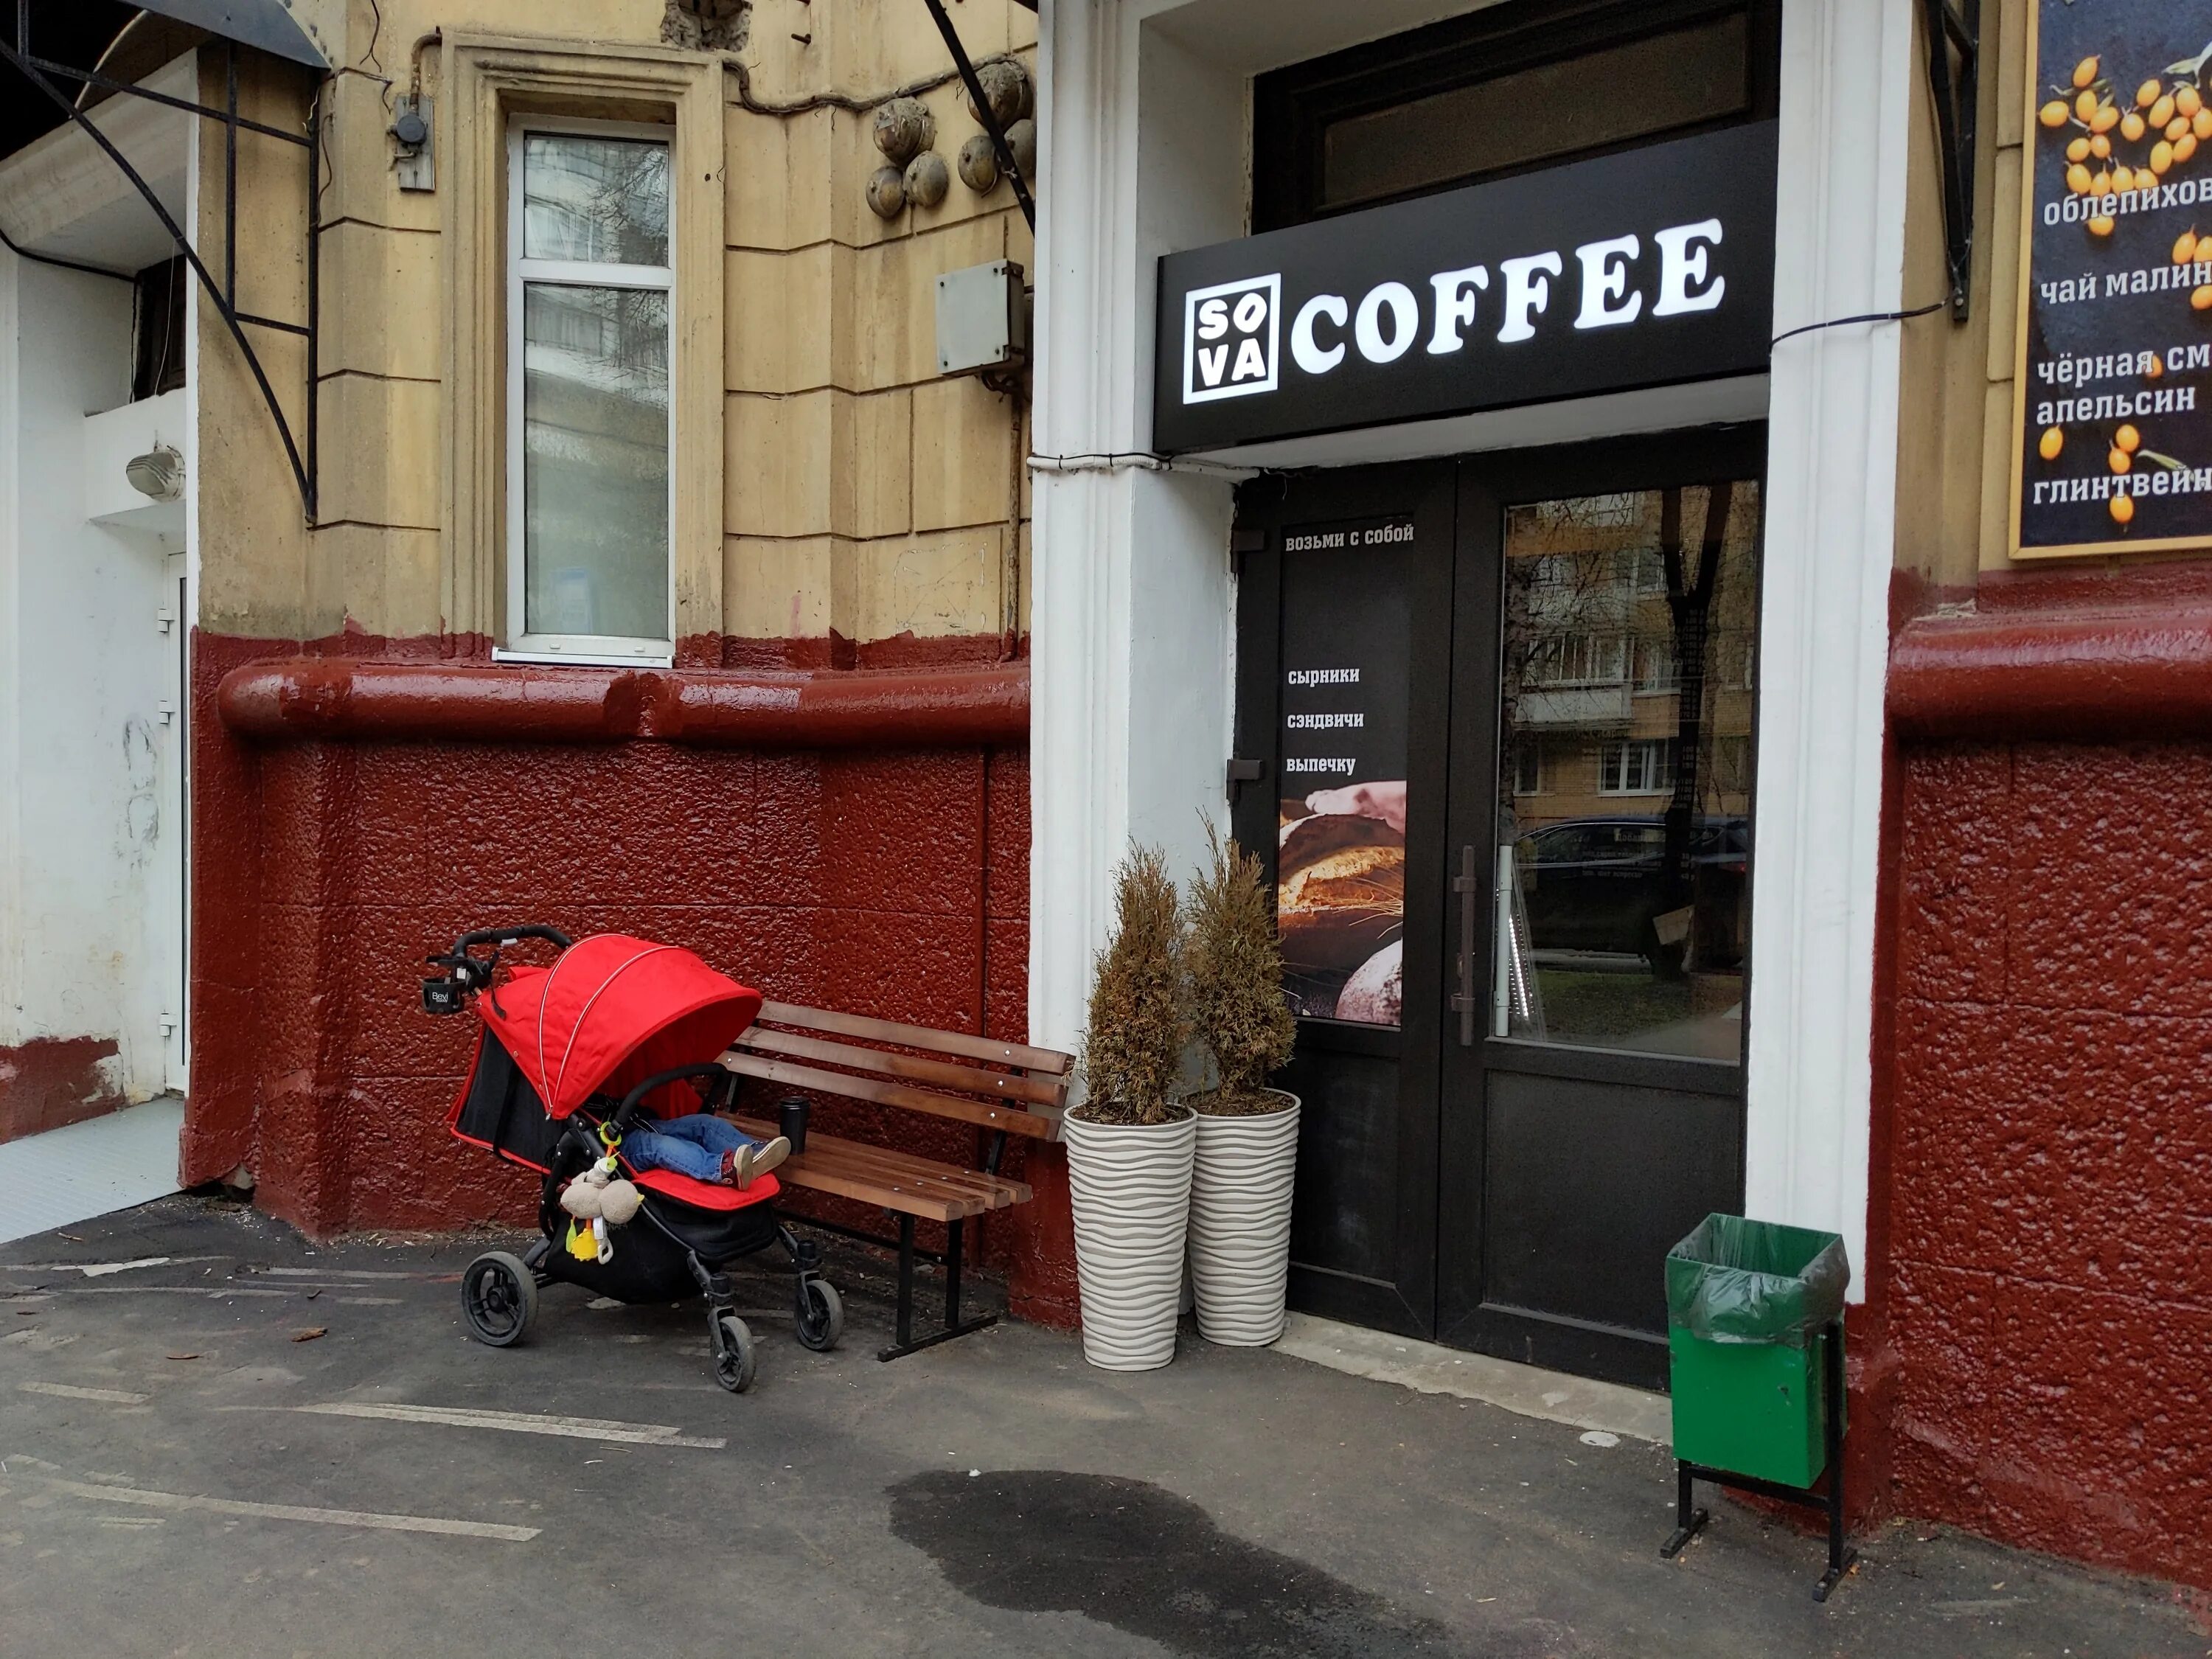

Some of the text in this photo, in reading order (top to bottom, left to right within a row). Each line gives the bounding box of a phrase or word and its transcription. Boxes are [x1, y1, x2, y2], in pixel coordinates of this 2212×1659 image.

[2043, 177, 2212, 226] облепихов
[1290, 218, 1726, 375] COFFEE
[2039, 260, 2212, 305] чай малин
[1197, 292, 1267, 341] SO
[1197, 337, 1267, 387] VA
[2037, 344, 2211, 386] чёрная см
[2036, 386, 2196, 425] апельсин
[2033, 465, 2212, 505] глинтвейн
[1285, 523, 1414, 552] возьми с собой
[1287, 668, 1360, 687] сырники
[1287, 713, 1364, 730] сэндвичи
[1286, 757, 1356, 776] выпечку
[432, 992, 448, 1000] Bevi
